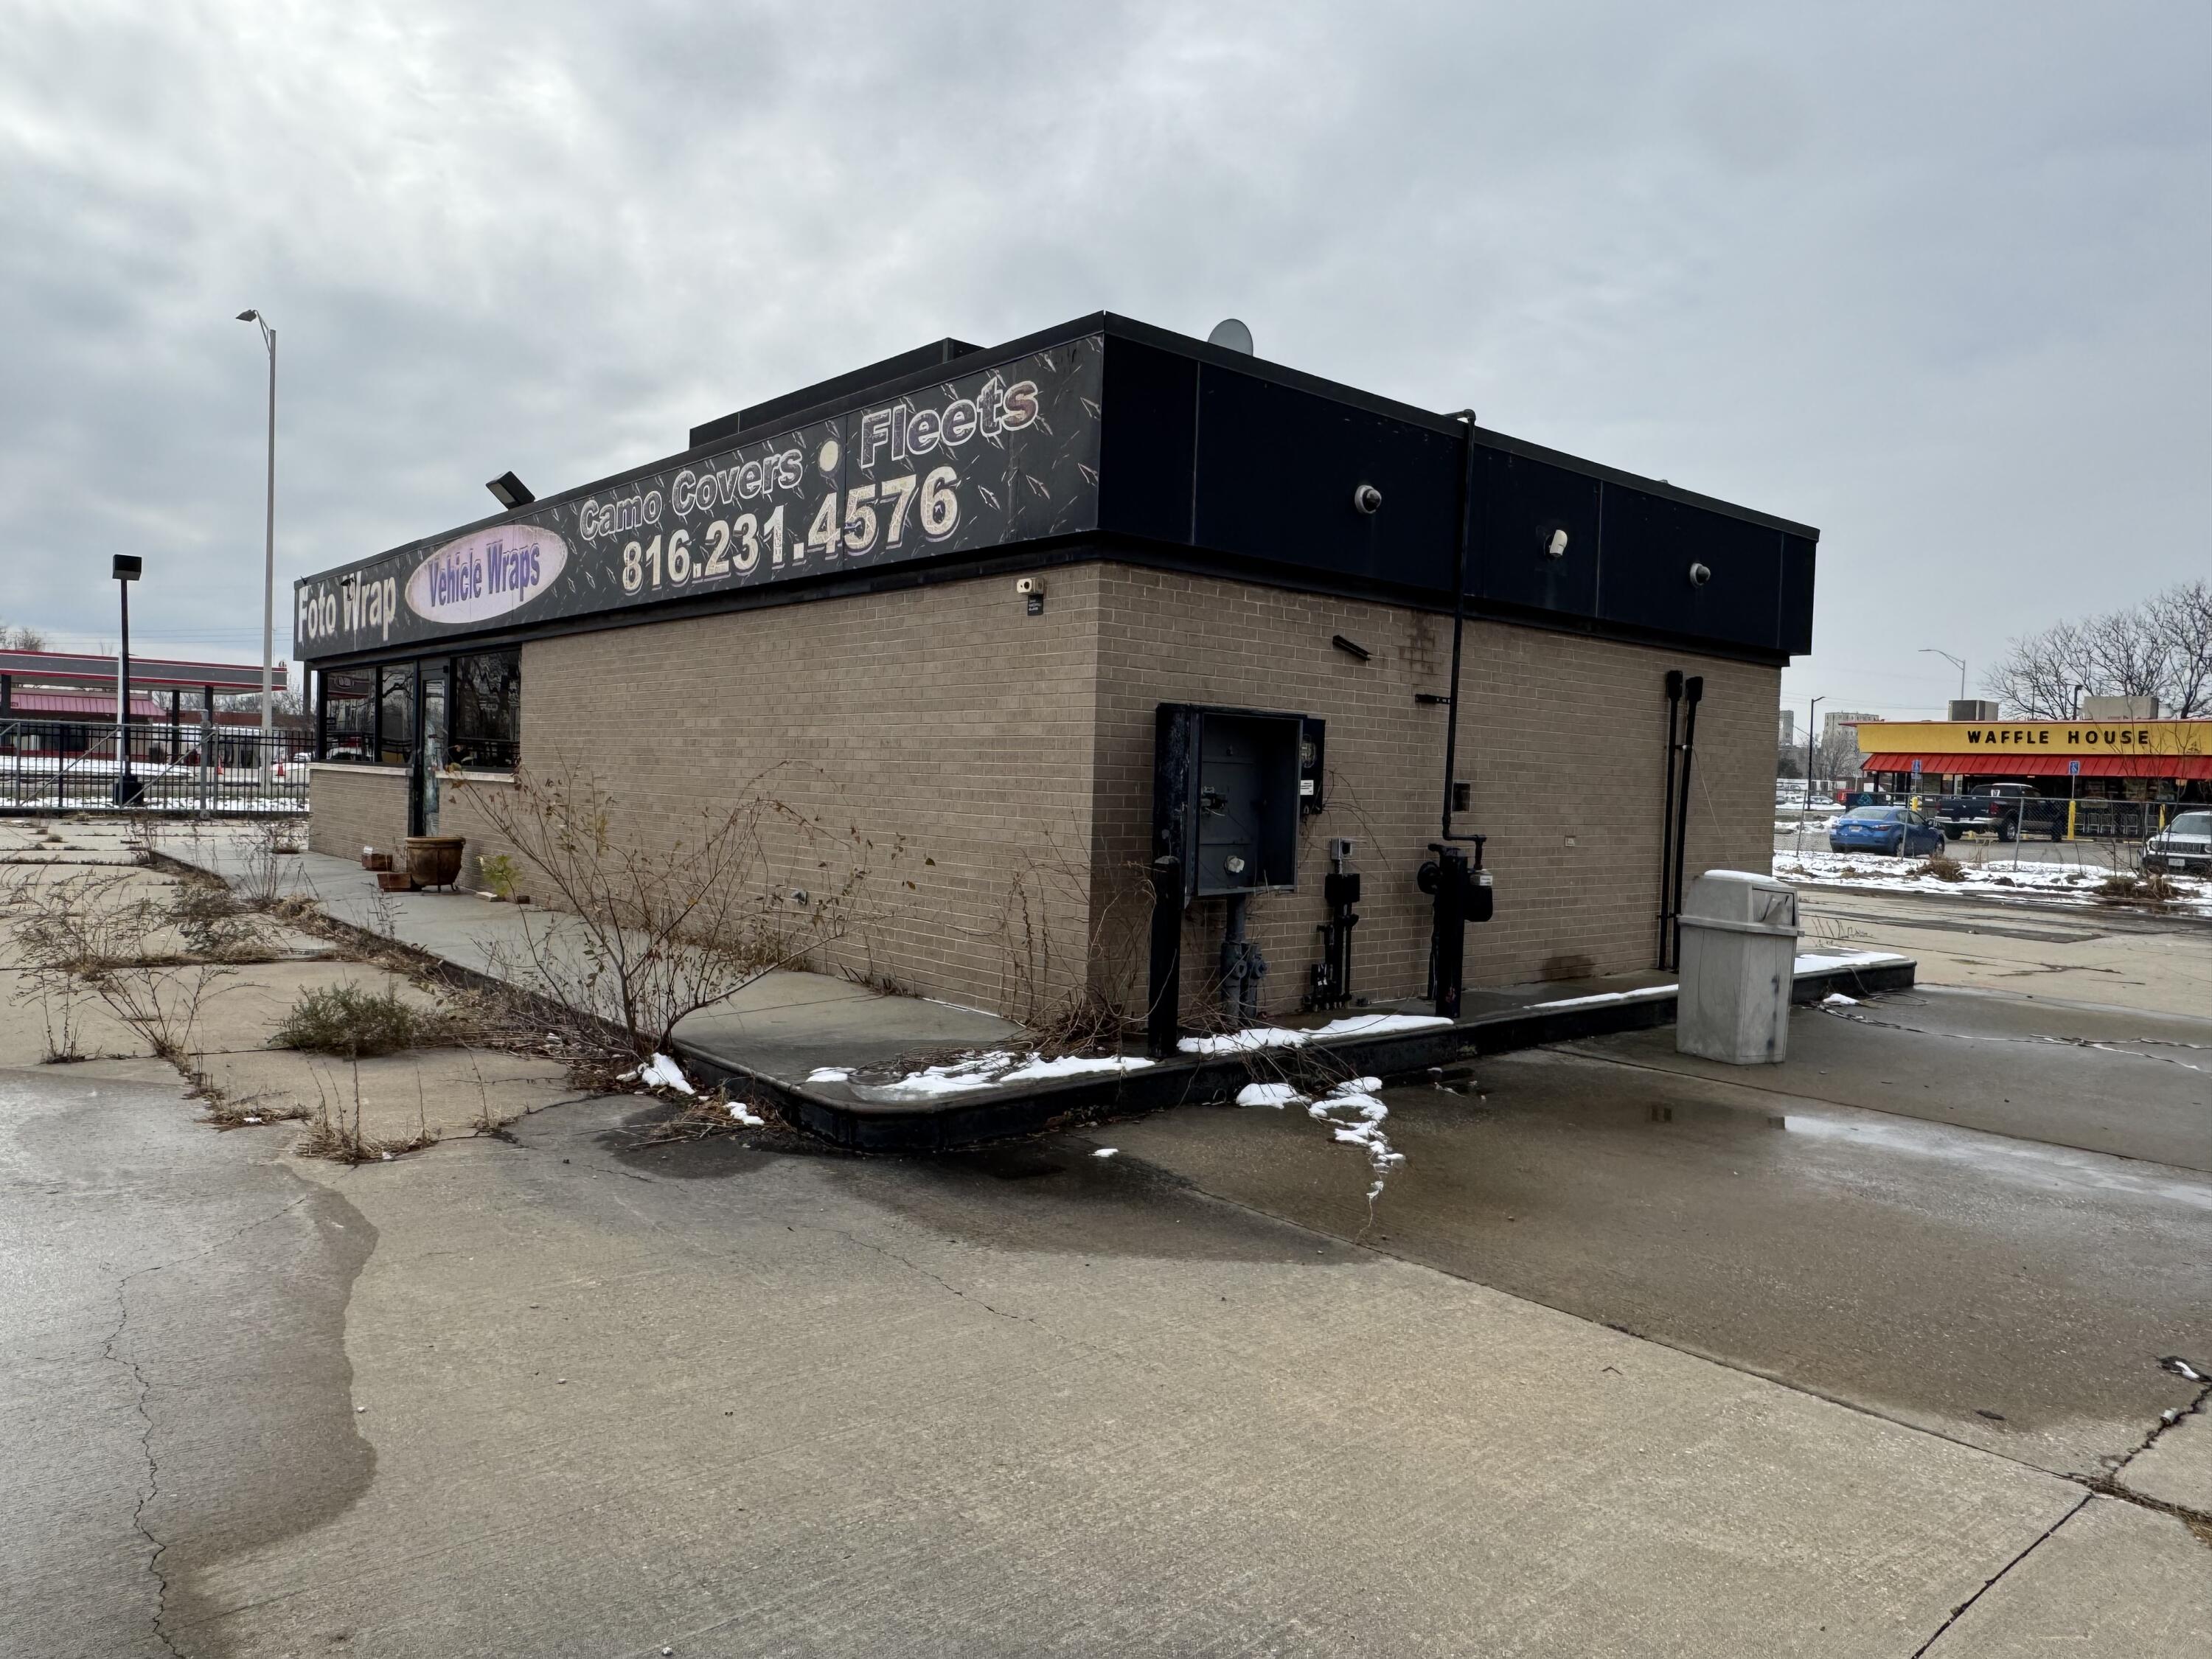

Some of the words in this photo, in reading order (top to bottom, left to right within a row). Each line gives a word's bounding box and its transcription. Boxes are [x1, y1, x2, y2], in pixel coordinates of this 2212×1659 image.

[580, 491, 662, 540] Camo
[672, 449, 803, 516] Covers
[860, 375, 1039, 469] Fleets
[622, 466, 961, 594] 816.231.4576
[298, 582, 337, 643] Foto
[342, 571, 397, 641] Wrap
[427, 549, 482, 607] Vehicle
[487, 539, 541, 602] Wraps
[1967, 730, 2050, 744] WAFFLE
[2067, 730, 2149, 745] HOUSE
